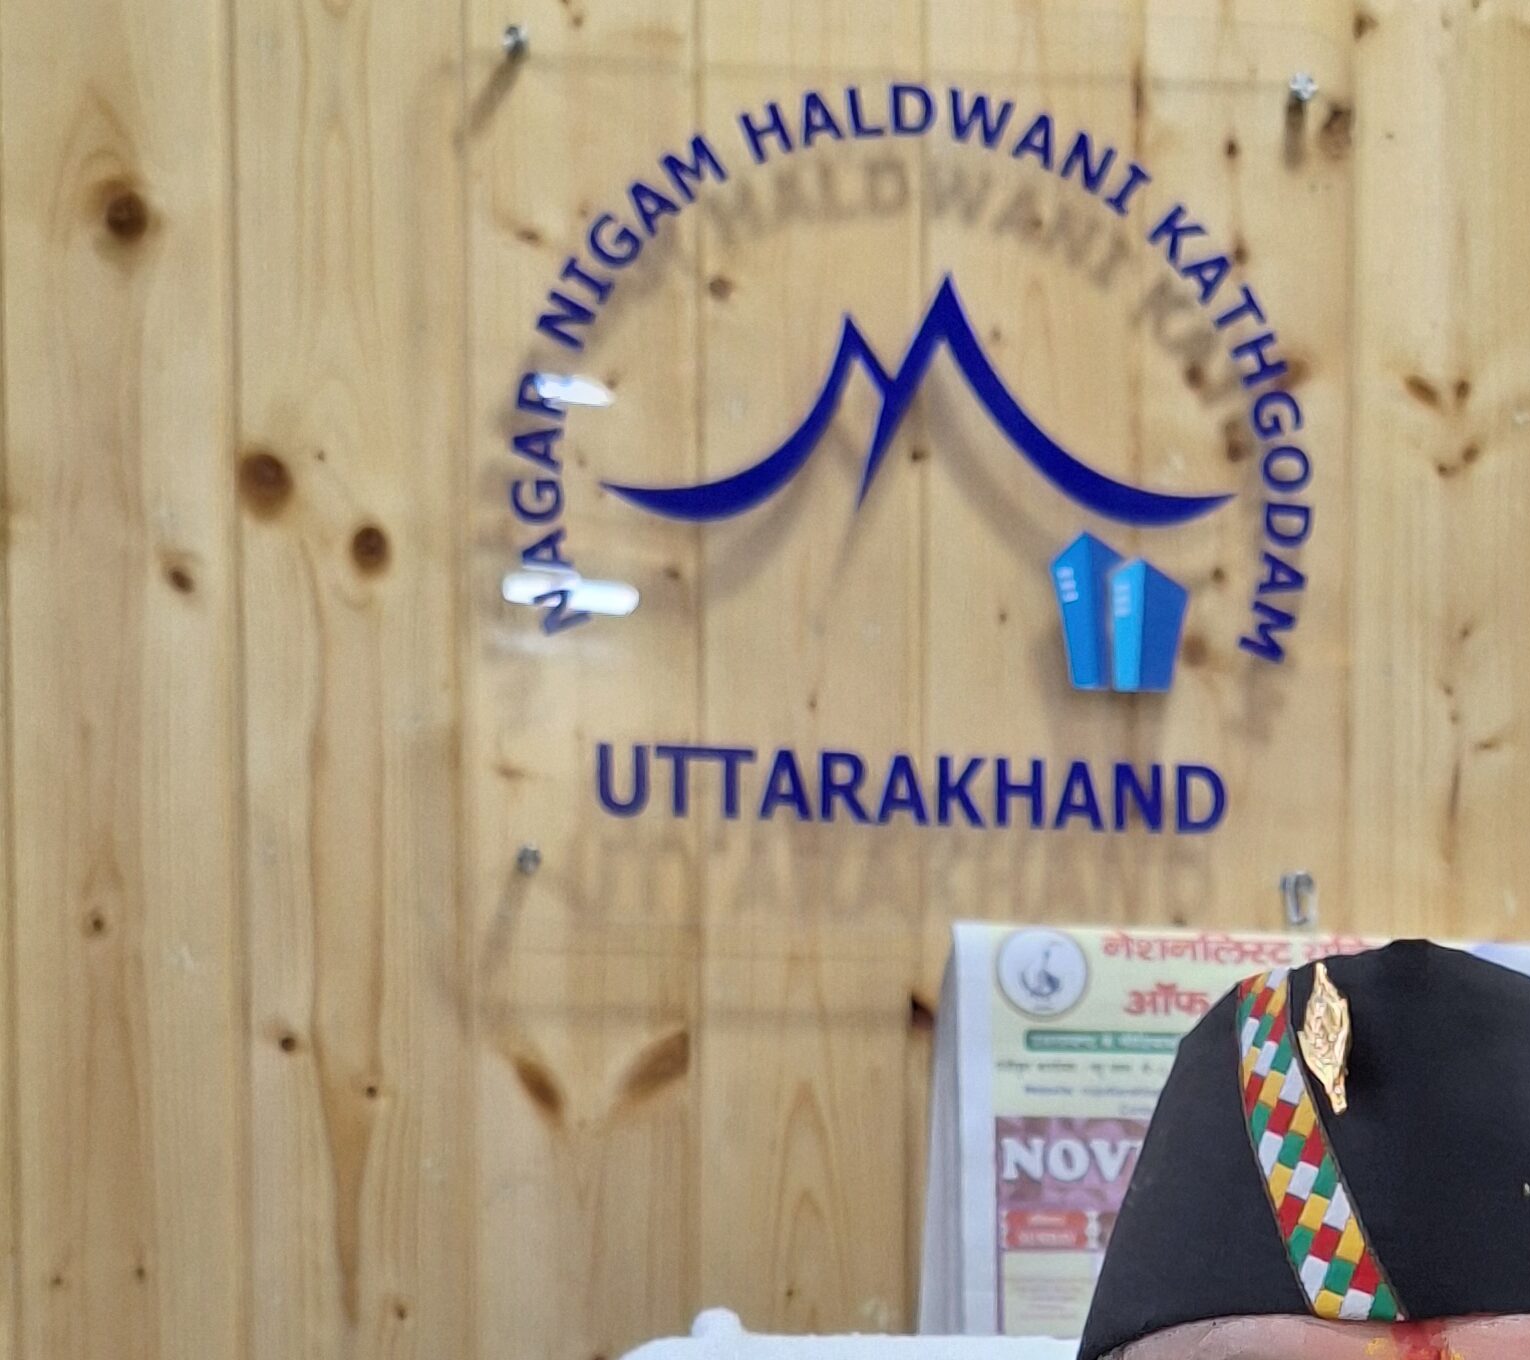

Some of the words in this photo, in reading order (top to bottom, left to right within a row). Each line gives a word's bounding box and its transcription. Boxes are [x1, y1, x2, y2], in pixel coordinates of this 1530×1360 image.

[738, 83, 1148, 213] HALDWANI
[536, 135, 727, 351] NIGAM
[510, 370, 593, 635] NAGAR
[1149, 205, 1312, 663] KATHGODAM
[596, 743, 1229, 835] UTTARAKHAND
[1000, 1136, 1143, 1184] NOV
